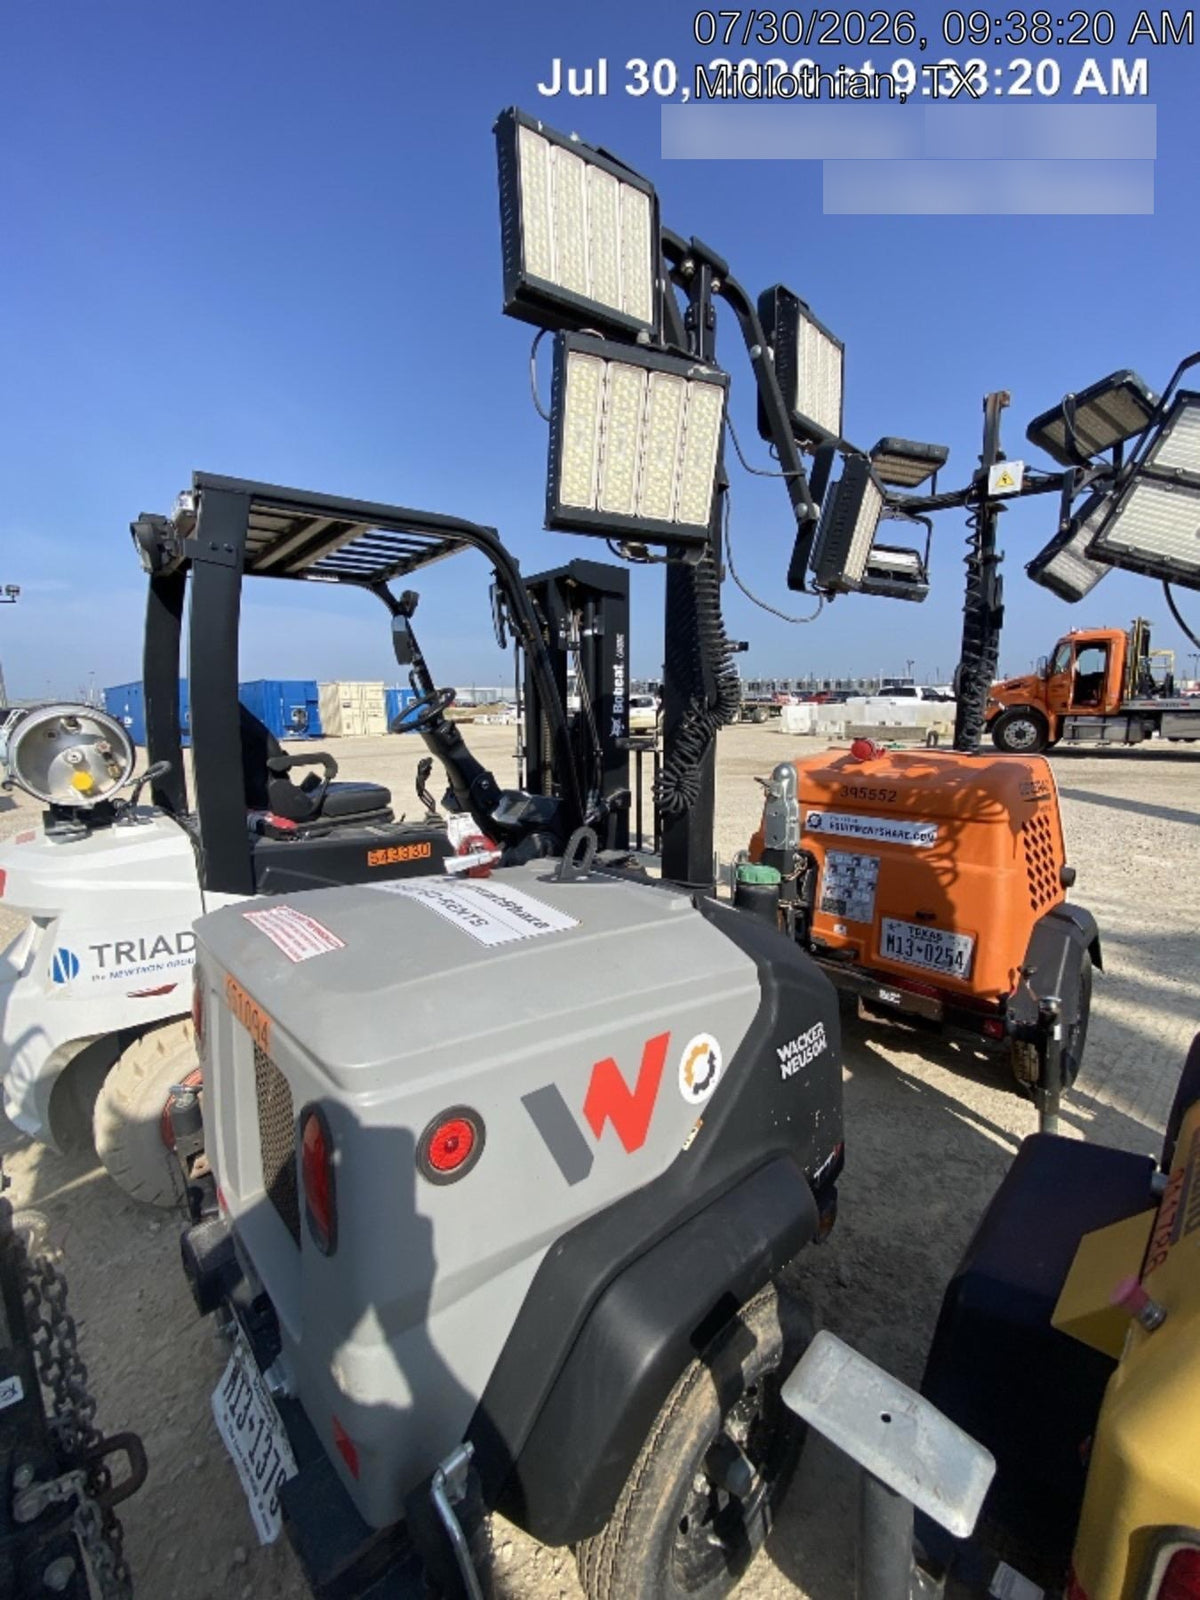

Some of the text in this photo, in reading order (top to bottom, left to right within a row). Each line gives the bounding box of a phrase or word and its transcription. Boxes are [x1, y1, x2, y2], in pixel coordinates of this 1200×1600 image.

[612, 664, 625, 714] Bobcat
[840, 785, 897, 803] 395552
[89, 932, 197, 967] TRIAD
[777, 1022, 825, 1062] WACKER
[780, 1036, 827, 1080] NEUSON
